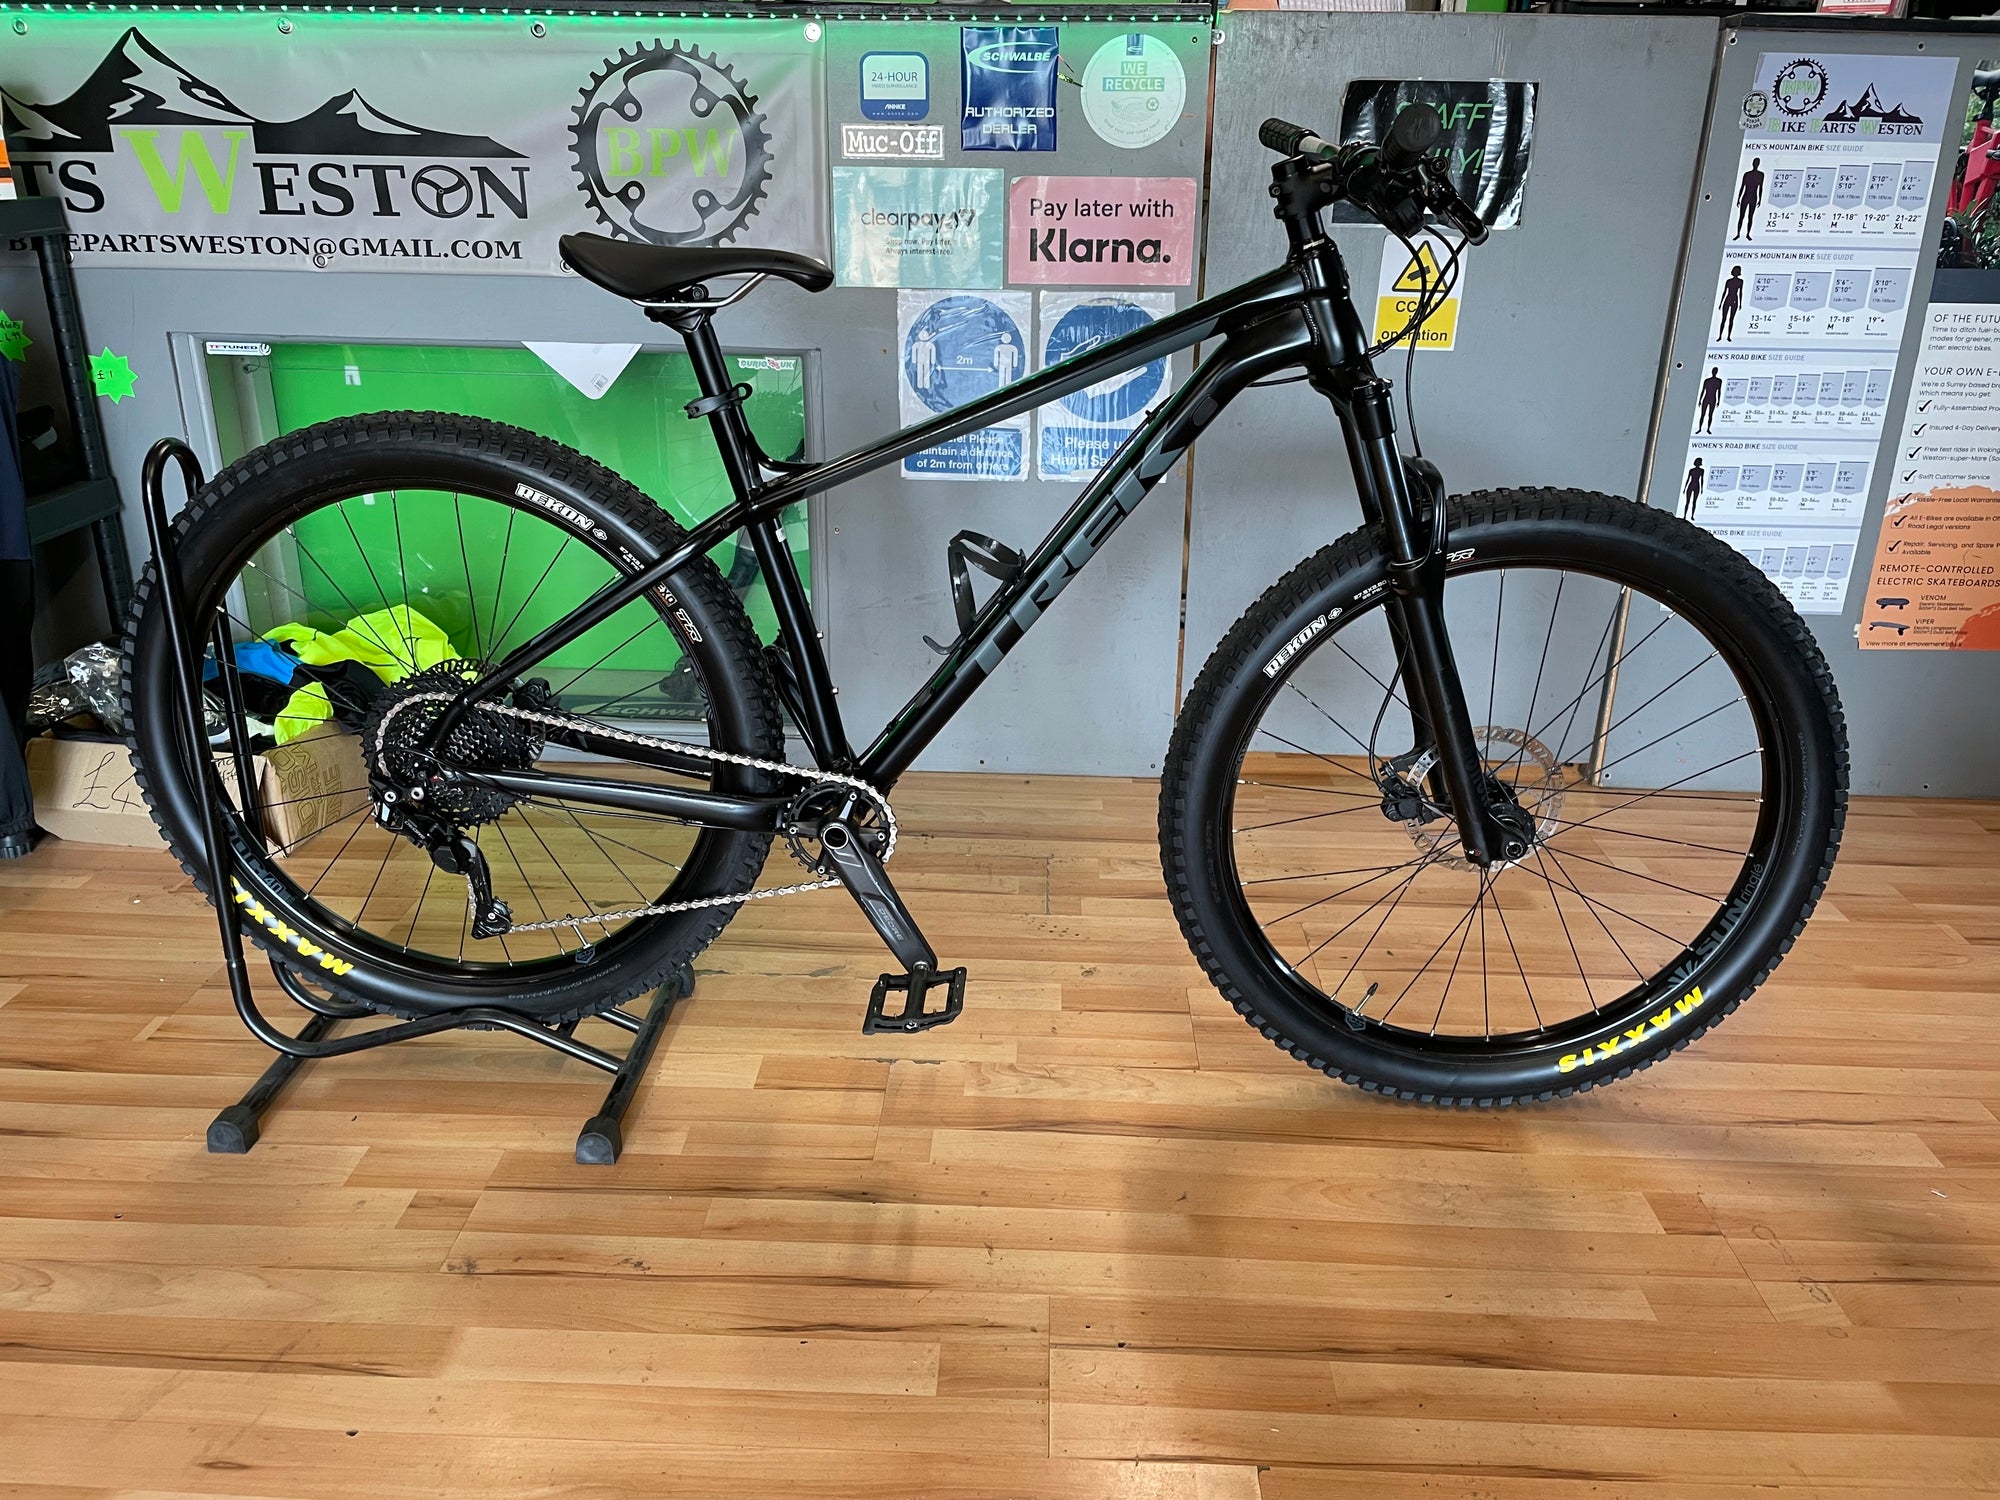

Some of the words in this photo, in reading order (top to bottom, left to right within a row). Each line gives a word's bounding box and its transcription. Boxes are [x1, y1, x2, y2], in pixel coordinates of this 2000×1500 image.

[983, 52, 1051, 62] SCHWALBE
[1123, 62, 1145, 74] WE
[871, 71, 918, 82] 24-HOUR
[1105, 79, 1162, 91] RECYCLE
[1781, 80, 1819, 96] BPW
[965, 107, 1055, 118] AUTHORIZED
[983, 124, 1037, 135] DEALER
[1768, 118, 1806, 134] BIKE
[1809, 118, 1857, 135] PARTS
[1860, 118, 1924, 136] WESTON
[848, 130, 938, 154] Muc-Off
[1745, 143, 1768, 151] MEN'S
[603, 127, 739, 178] BPW
[1030, 198, 1067, 222] Pay
[1074, 199, 1123, 217] later
[1129, 199, 1174, 218] with
[861, 207, 946, 233] clearpay
[8, 233, 522, 260] BIEPARTSWESTON@GMAIL.COM
[1029, 228, 1171, 264] Klarna.
[1934, 314, 1949, 323] OF
[1953, 314, 1972, 323] THE
[956, 355, 973, 365] 2m
[1924, 367, 1953, 376] YOUR
[1956, 367, 1984, 376] OWN
[969, 434, 1004, 445] Please
[1064, 436, 1110, 451] Please
[916, 446, 958, 456] aintain
[1777, 443, 1799, 451] GUIDE
[916, 459, 928, 468] of
[930, 459, 946, 469] 2m
[948, 460, 973, 469] from
[976, 461, 1010, 471] others
[1051, 453, 1087, 467] Hand
[515, 483, 595, 531] REKON
[1879, 564, 1994, 575] REMOTE-CONTROLLED
[1876, 577, 1924, 586] ELECTRIC
[1926, 577, 2000, 588] SKATEBOARDS
[1263, 615, 1328, 678] REKON
[1558, 986, 1705, 1073] MAXXIS
